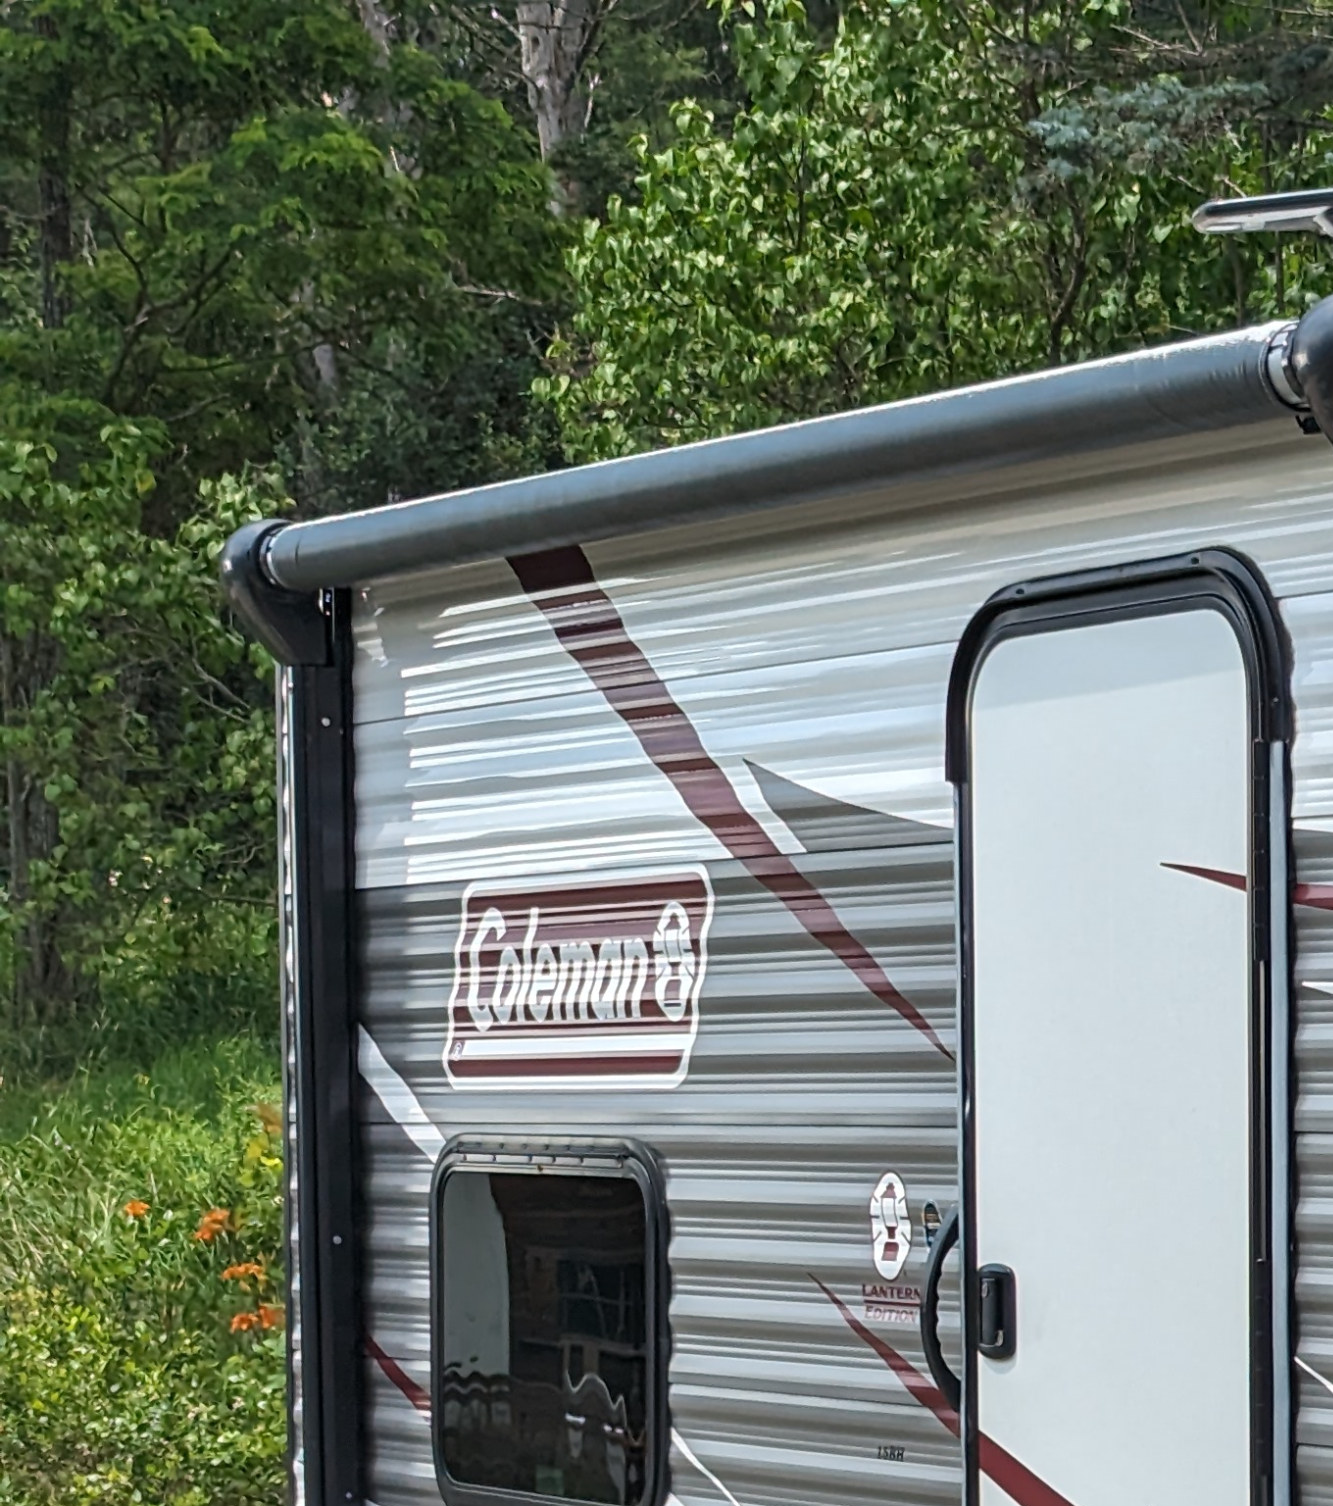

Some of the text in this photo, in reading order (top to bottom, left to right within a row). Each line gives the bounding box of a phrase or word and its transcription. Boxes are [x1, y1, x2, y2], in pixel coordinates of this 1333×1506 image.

[467, 906, 650, 1033] Coleman
[862, 1284, 921, 1300] LANTERN
[865, 1305, 918, 1323] EDITION
